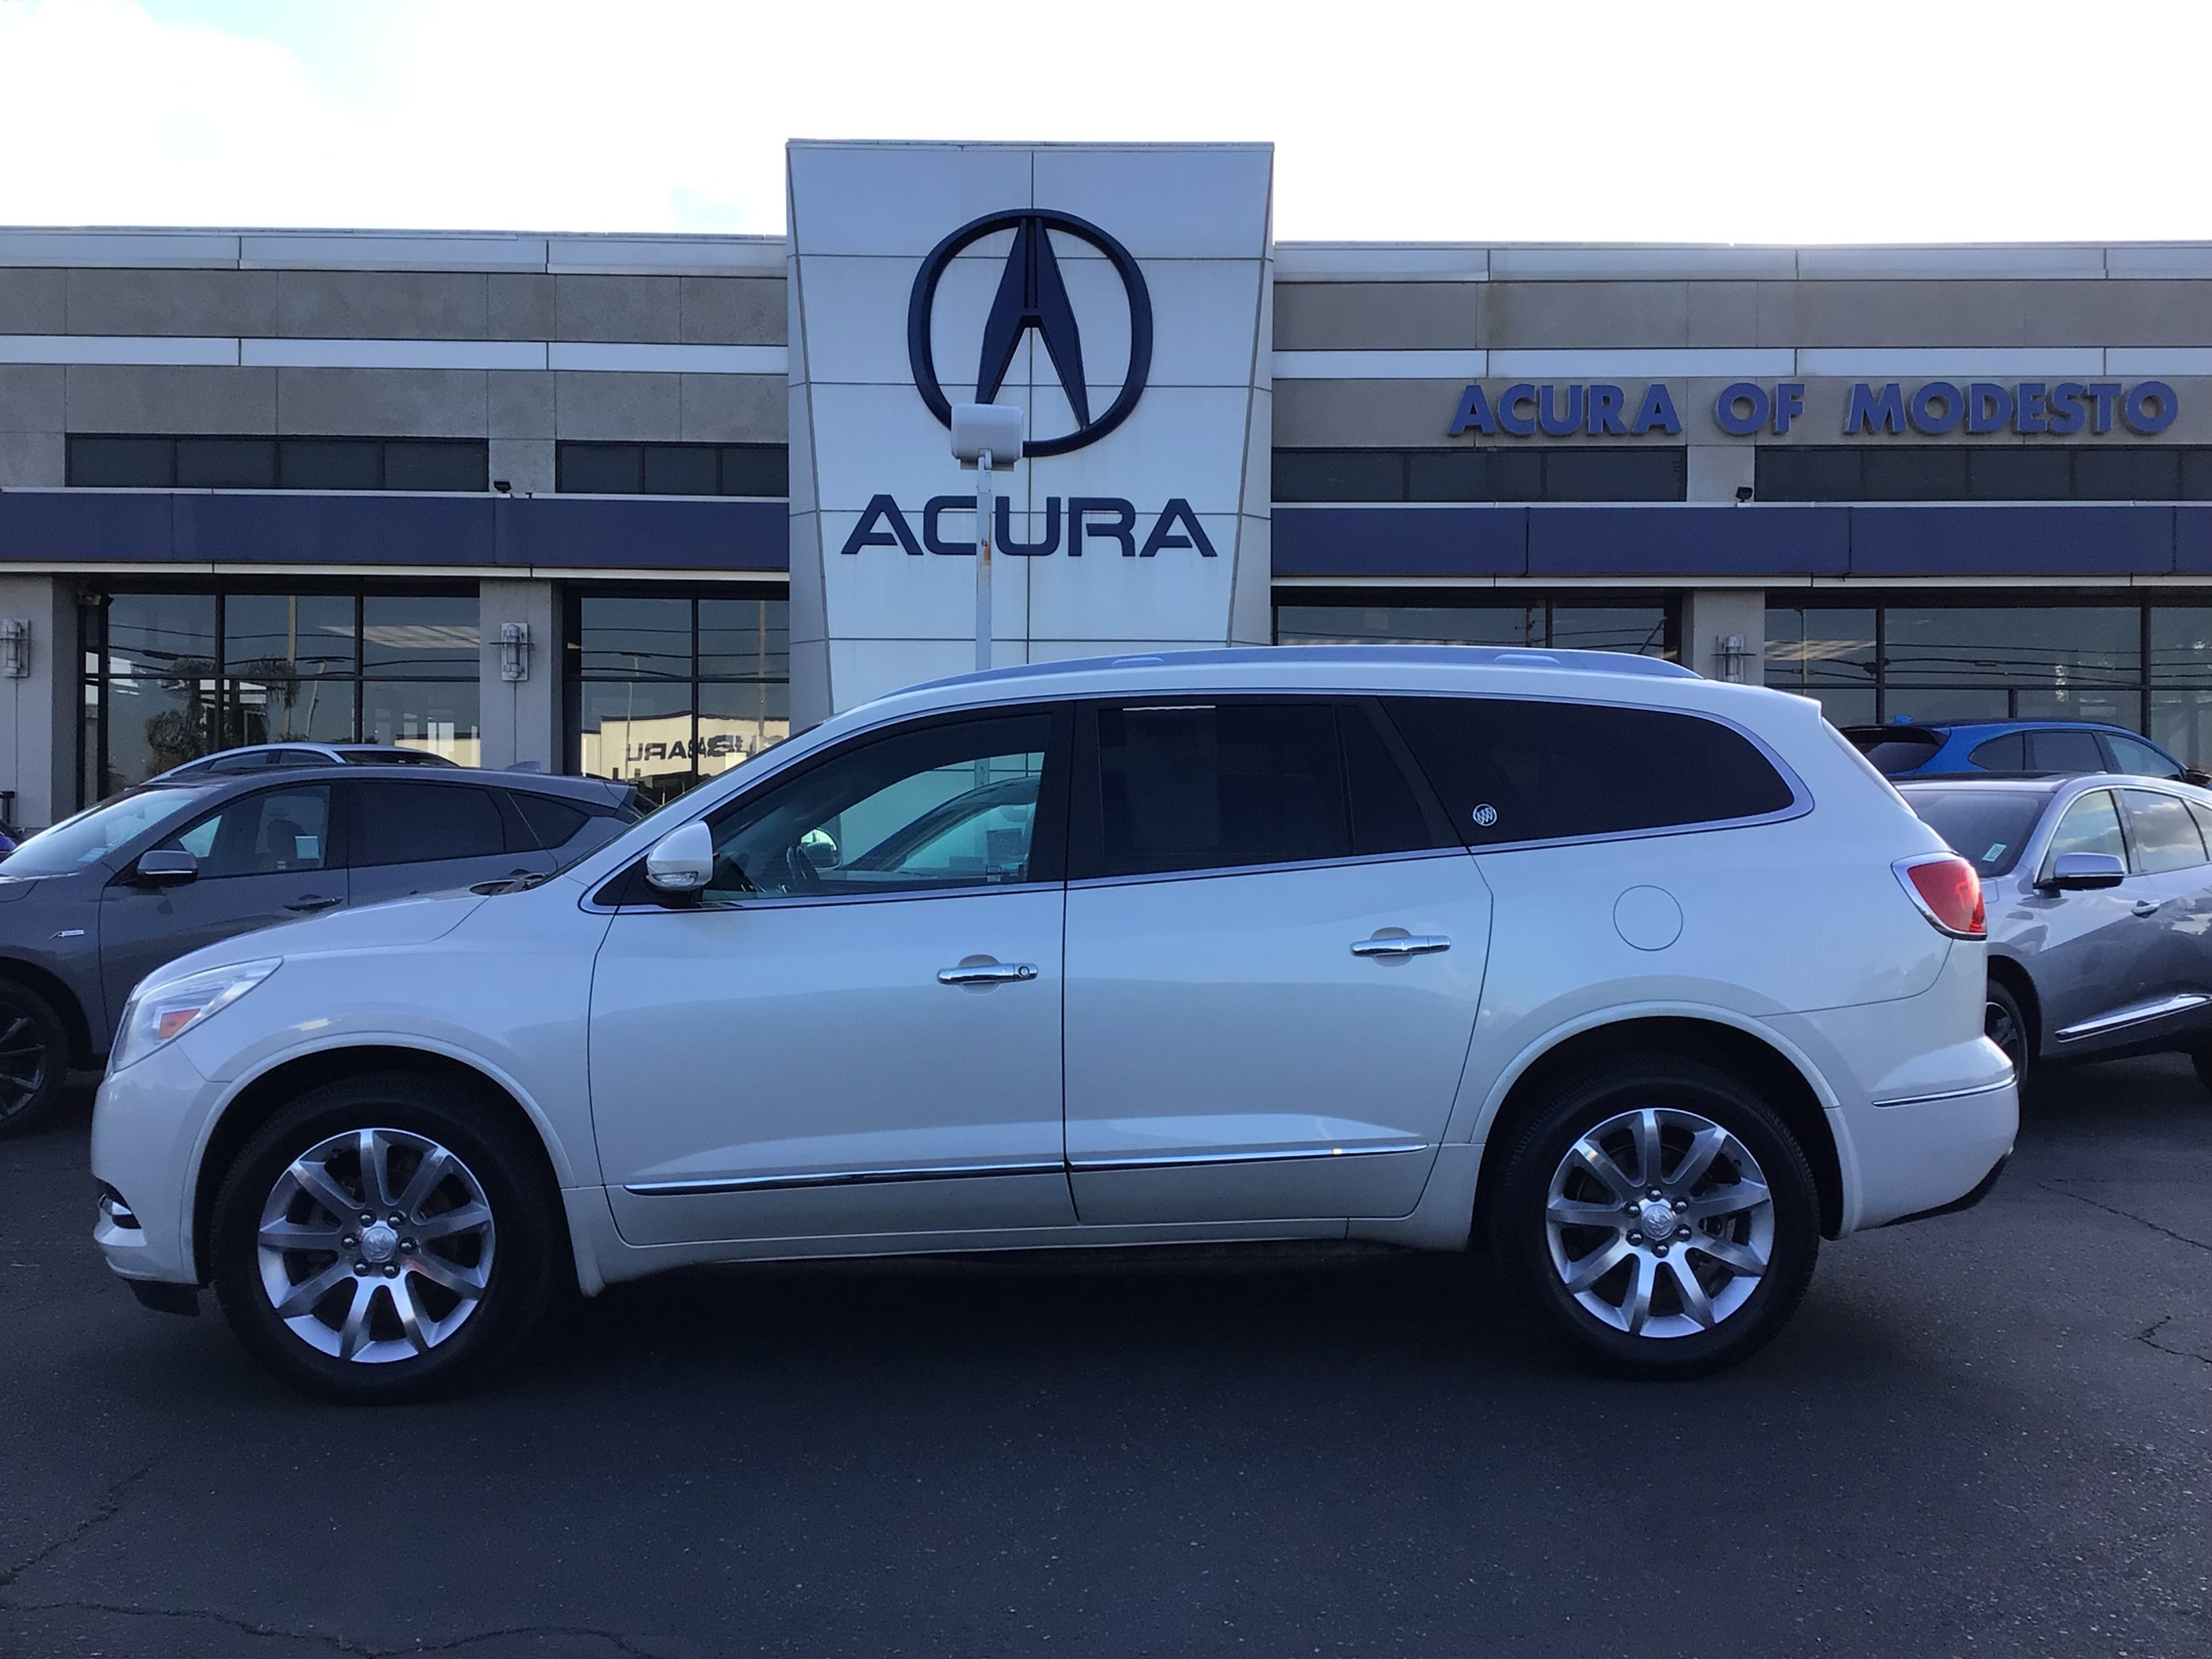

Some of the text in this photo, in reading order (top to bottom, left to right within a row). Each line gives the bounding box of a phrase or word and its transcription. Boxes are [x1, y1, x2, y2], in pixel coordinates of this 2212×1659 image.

[1448, 381, 2179, 436] ACURA OF MODESTO
[840, 494, 1217, 558] ACURA
